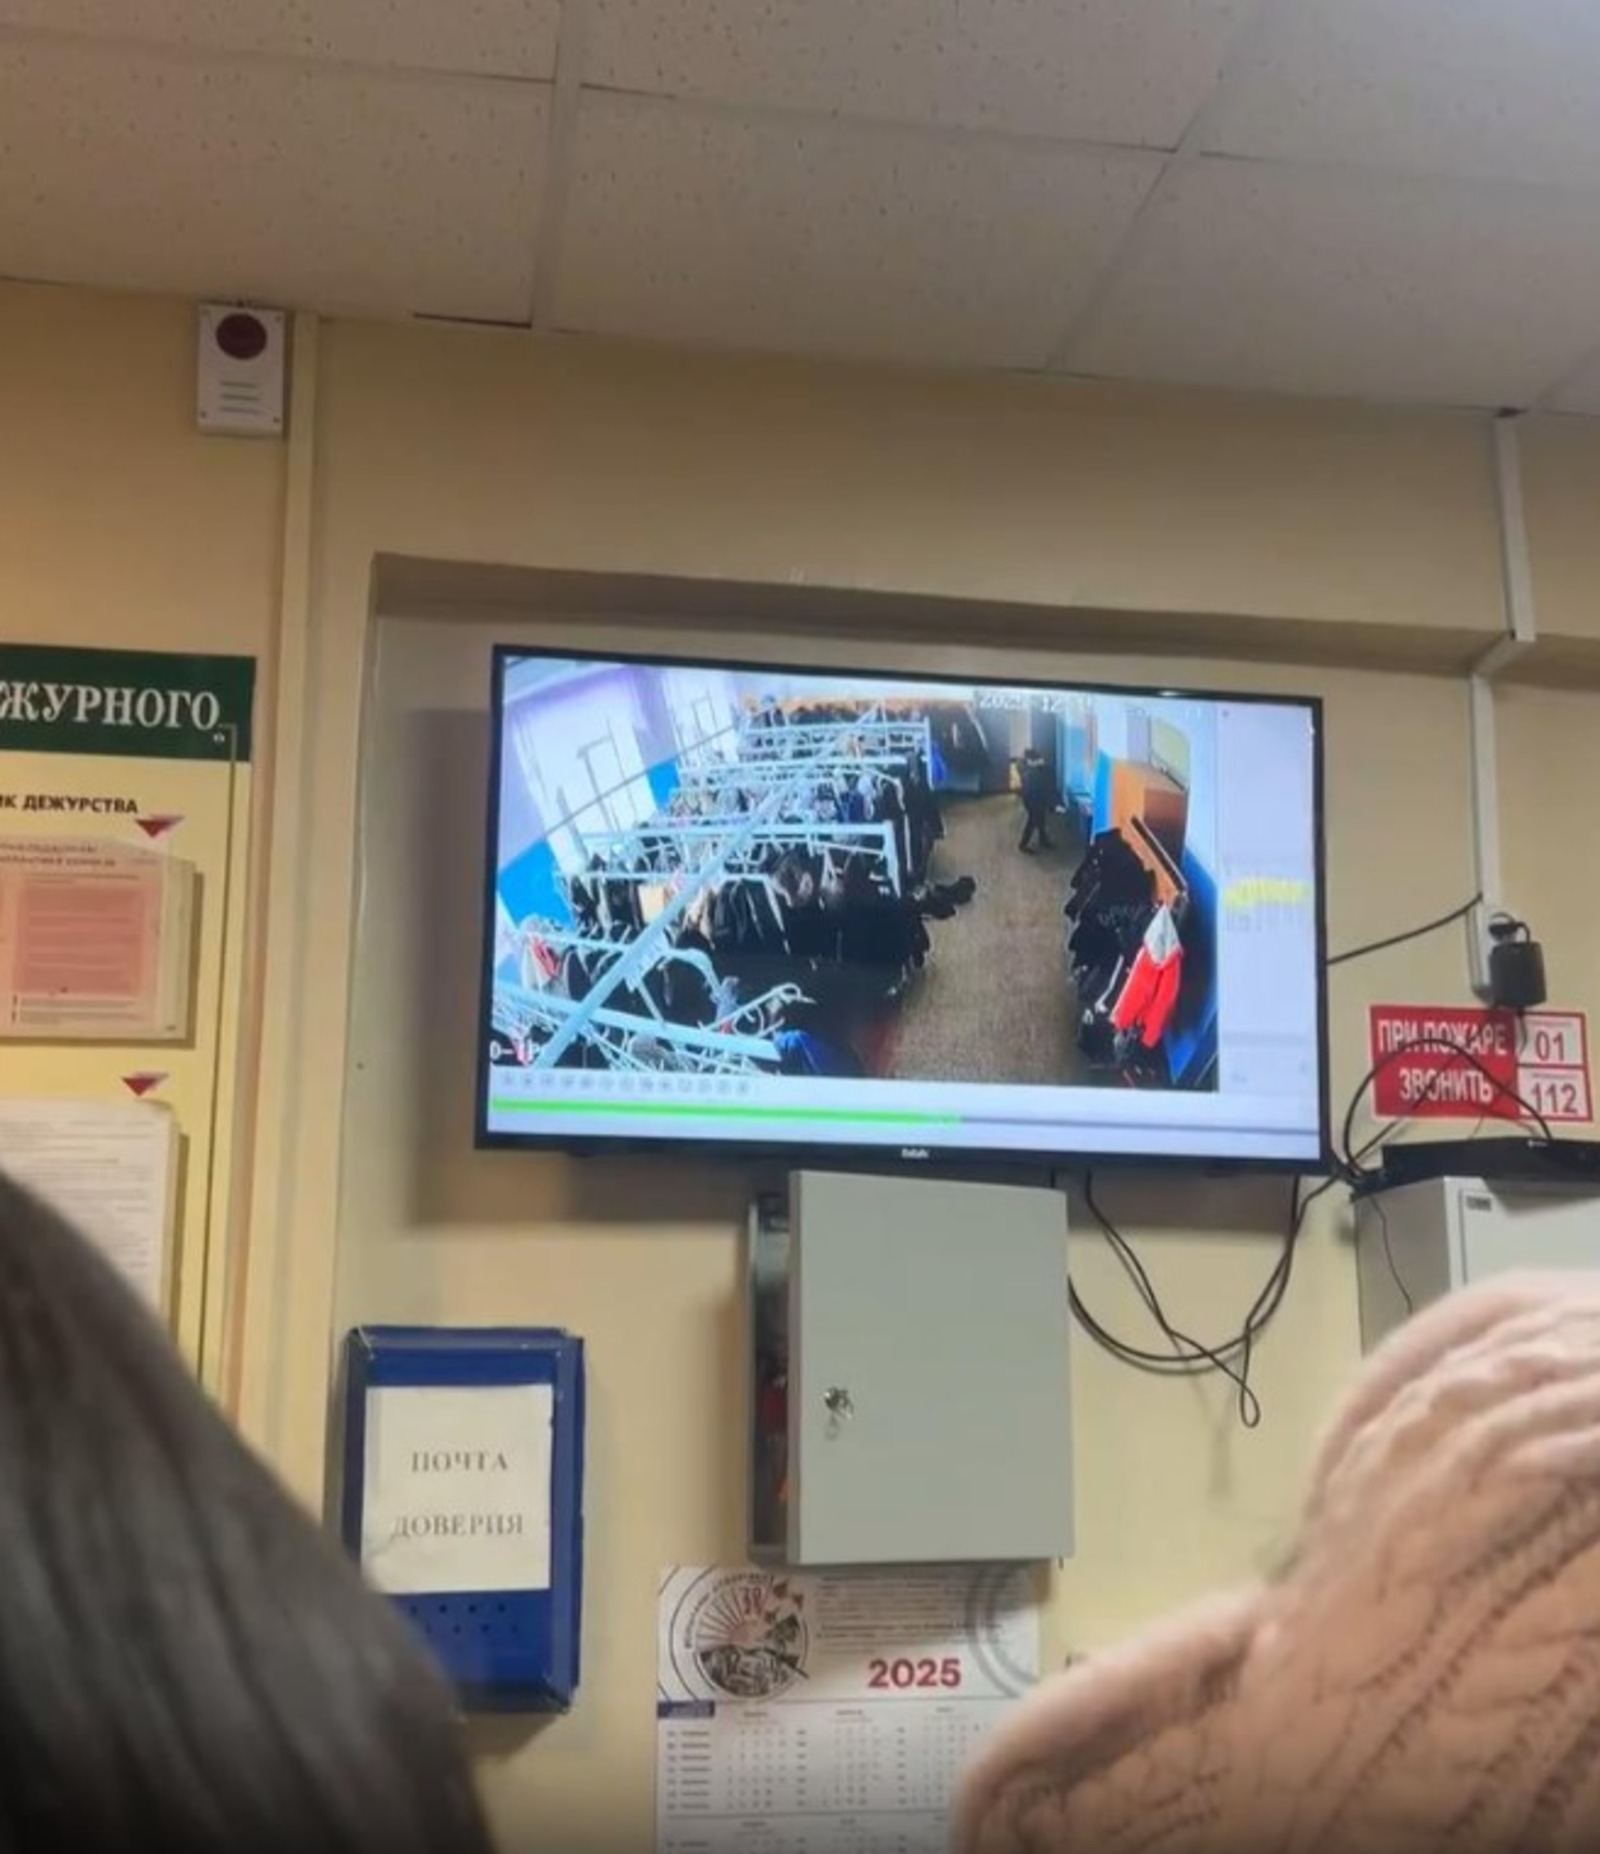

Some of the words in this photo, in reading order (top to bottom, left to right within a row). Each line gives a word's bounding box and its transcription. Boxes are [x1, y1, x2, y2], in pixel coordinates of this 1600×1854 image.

[0, 680, 220, 731] ЖУРНОГО
[22, 794, 138, 814] ДЕЖУРСТВА
[1377, 1019, 1419, 1053] ПРИ
[1423, 1020, 1507, 1056] ПОЖАРЕ
[1535, 1031, 1565, 1061] 01
[1399, 1067, 1493, 1104] ЗВОНИТЬ
[1531, 1083, 1578, 1114] 112
[411, 1451, 509, 1473] ПОЧТА
[390, 1513, 523, 1540] ДОВЕРИЯ
[867, 1657, 962, 1690] 2025
